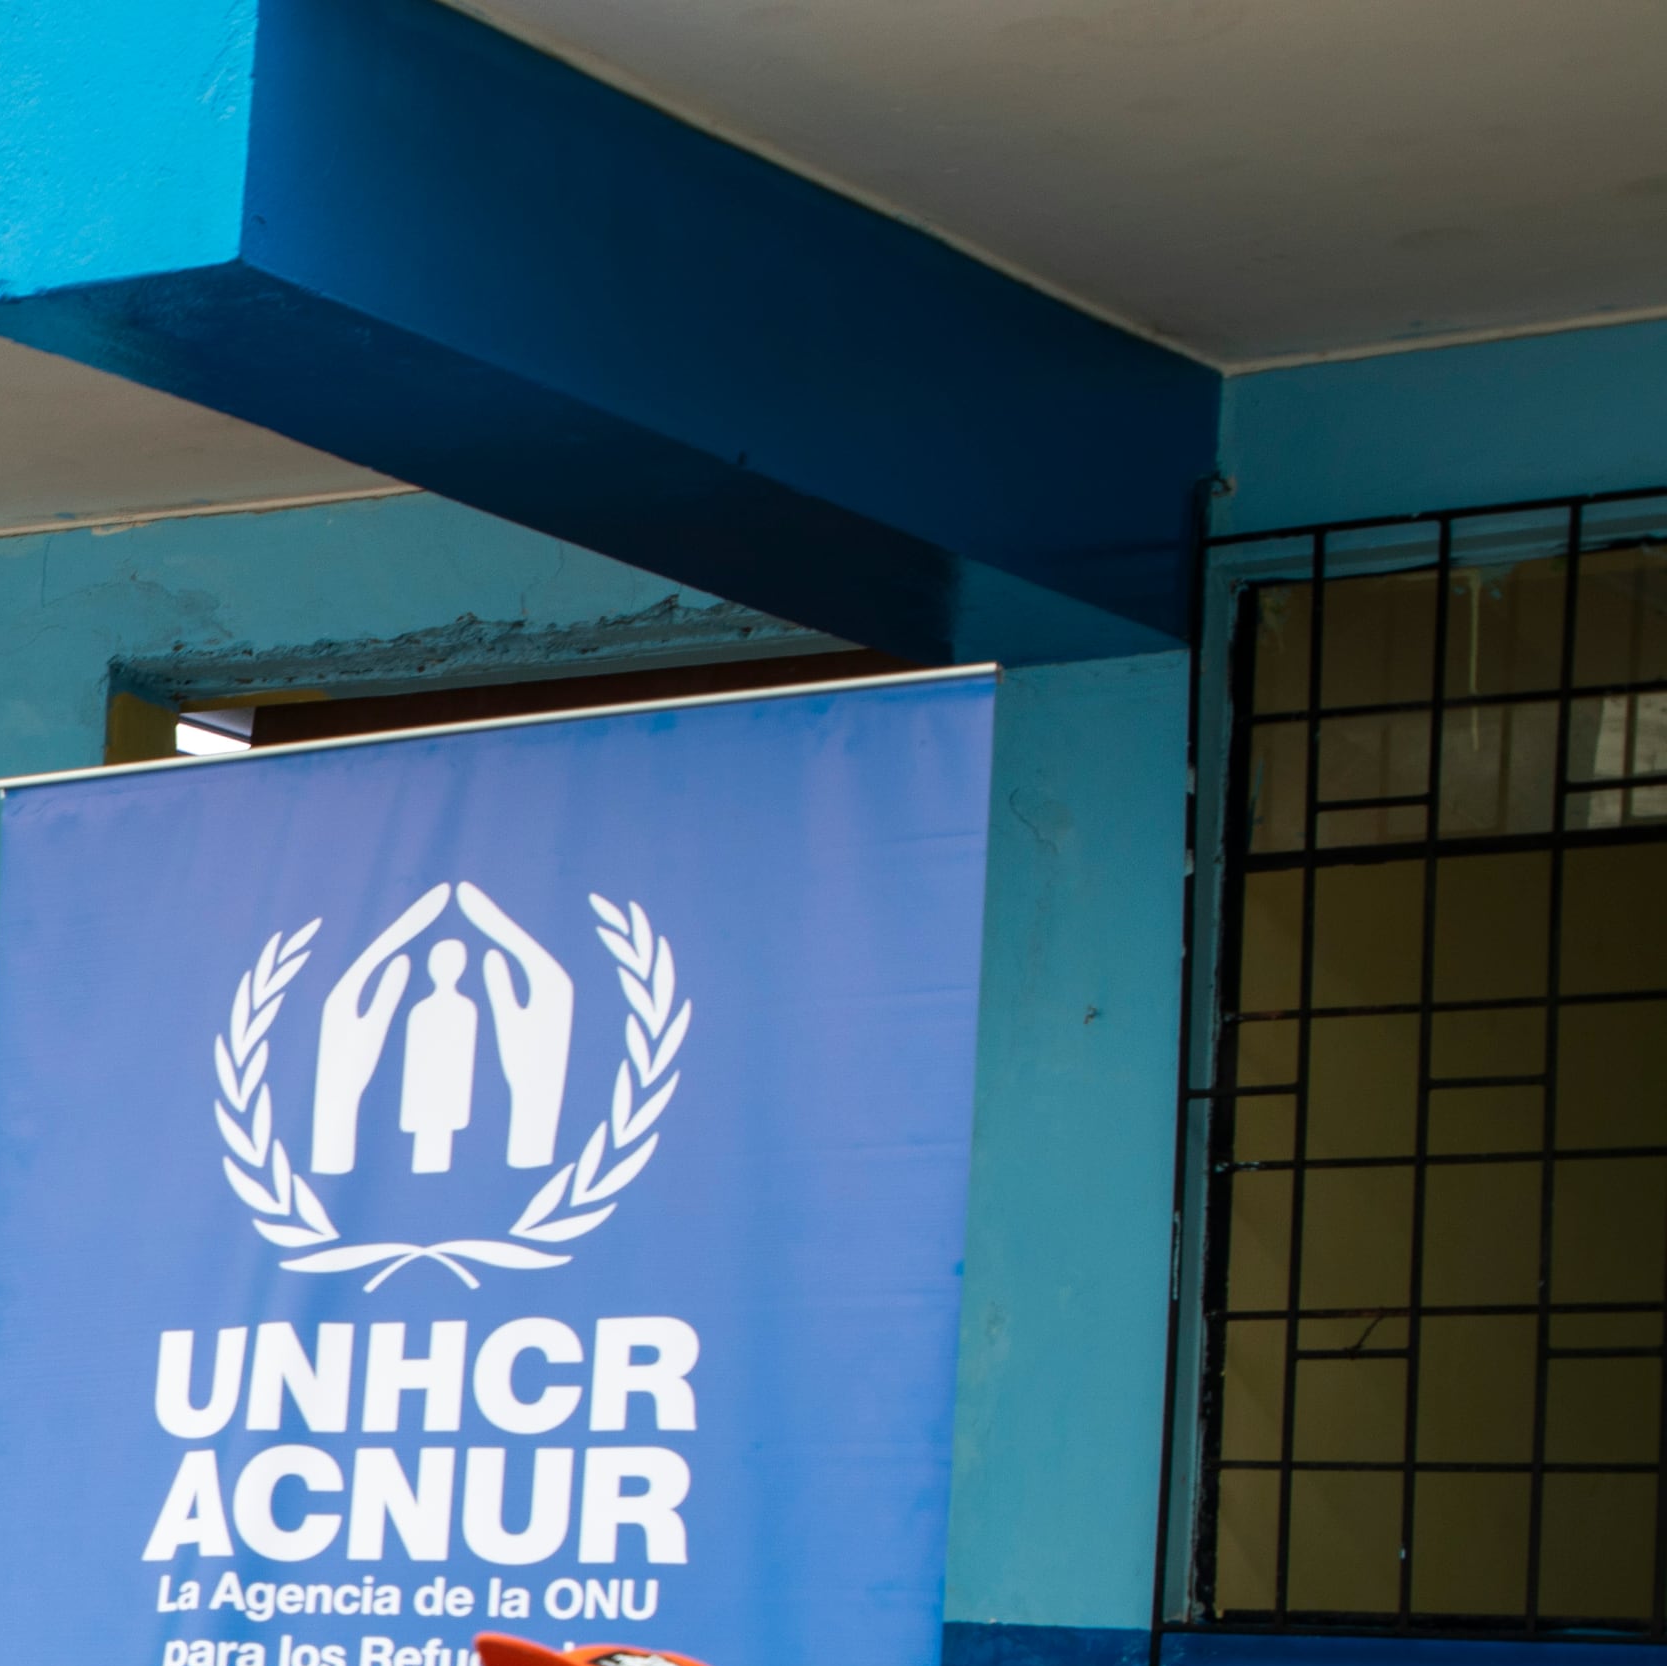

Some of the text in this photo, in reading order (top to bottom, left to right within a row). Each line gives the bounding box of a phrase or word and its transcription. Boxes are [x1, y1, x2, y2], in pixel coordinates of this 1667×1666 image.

[155, 1316, 700, 1439] UNHCR
[141, 1444, 691, 1566] ACNUR
[157, 1571, 659, 1622] La Agencia de la ONU
